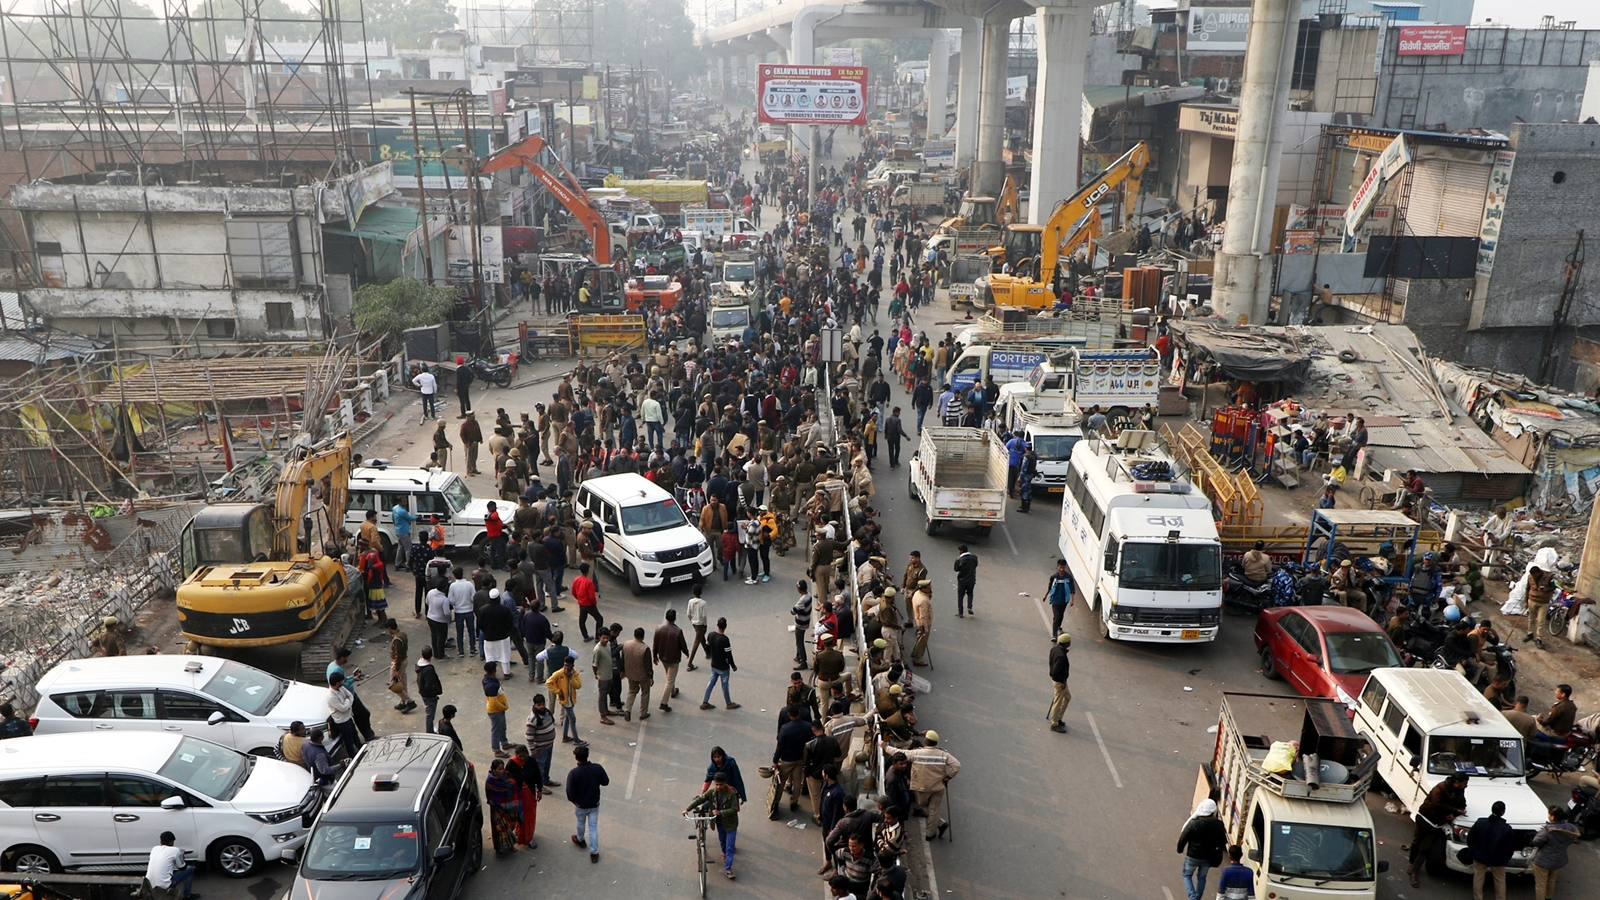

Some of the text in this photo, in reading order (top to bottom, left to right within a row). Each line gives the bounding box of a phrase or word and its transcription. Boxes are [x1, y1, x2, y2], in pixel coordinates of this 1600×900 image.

[1219, 13, 1249, 24] DURGA
[798, 68, 832, 76] INSTITUTES
[1200, 110, 1213, 125] Taj
[541, 174, 570, 202] TATA HITACHI
[1352, 168, 1378, 211] ASHOKA
[1085, 182, 1109, 208] JCB
[992, 353, 1035, 364] PORTER
[1109, 379, 1124, 390] ALL
[1146, 515, 1185, 528] वज्र
[1270, 556, 1288, 564] OLIC
[230, 618, 250, 634] JCB
